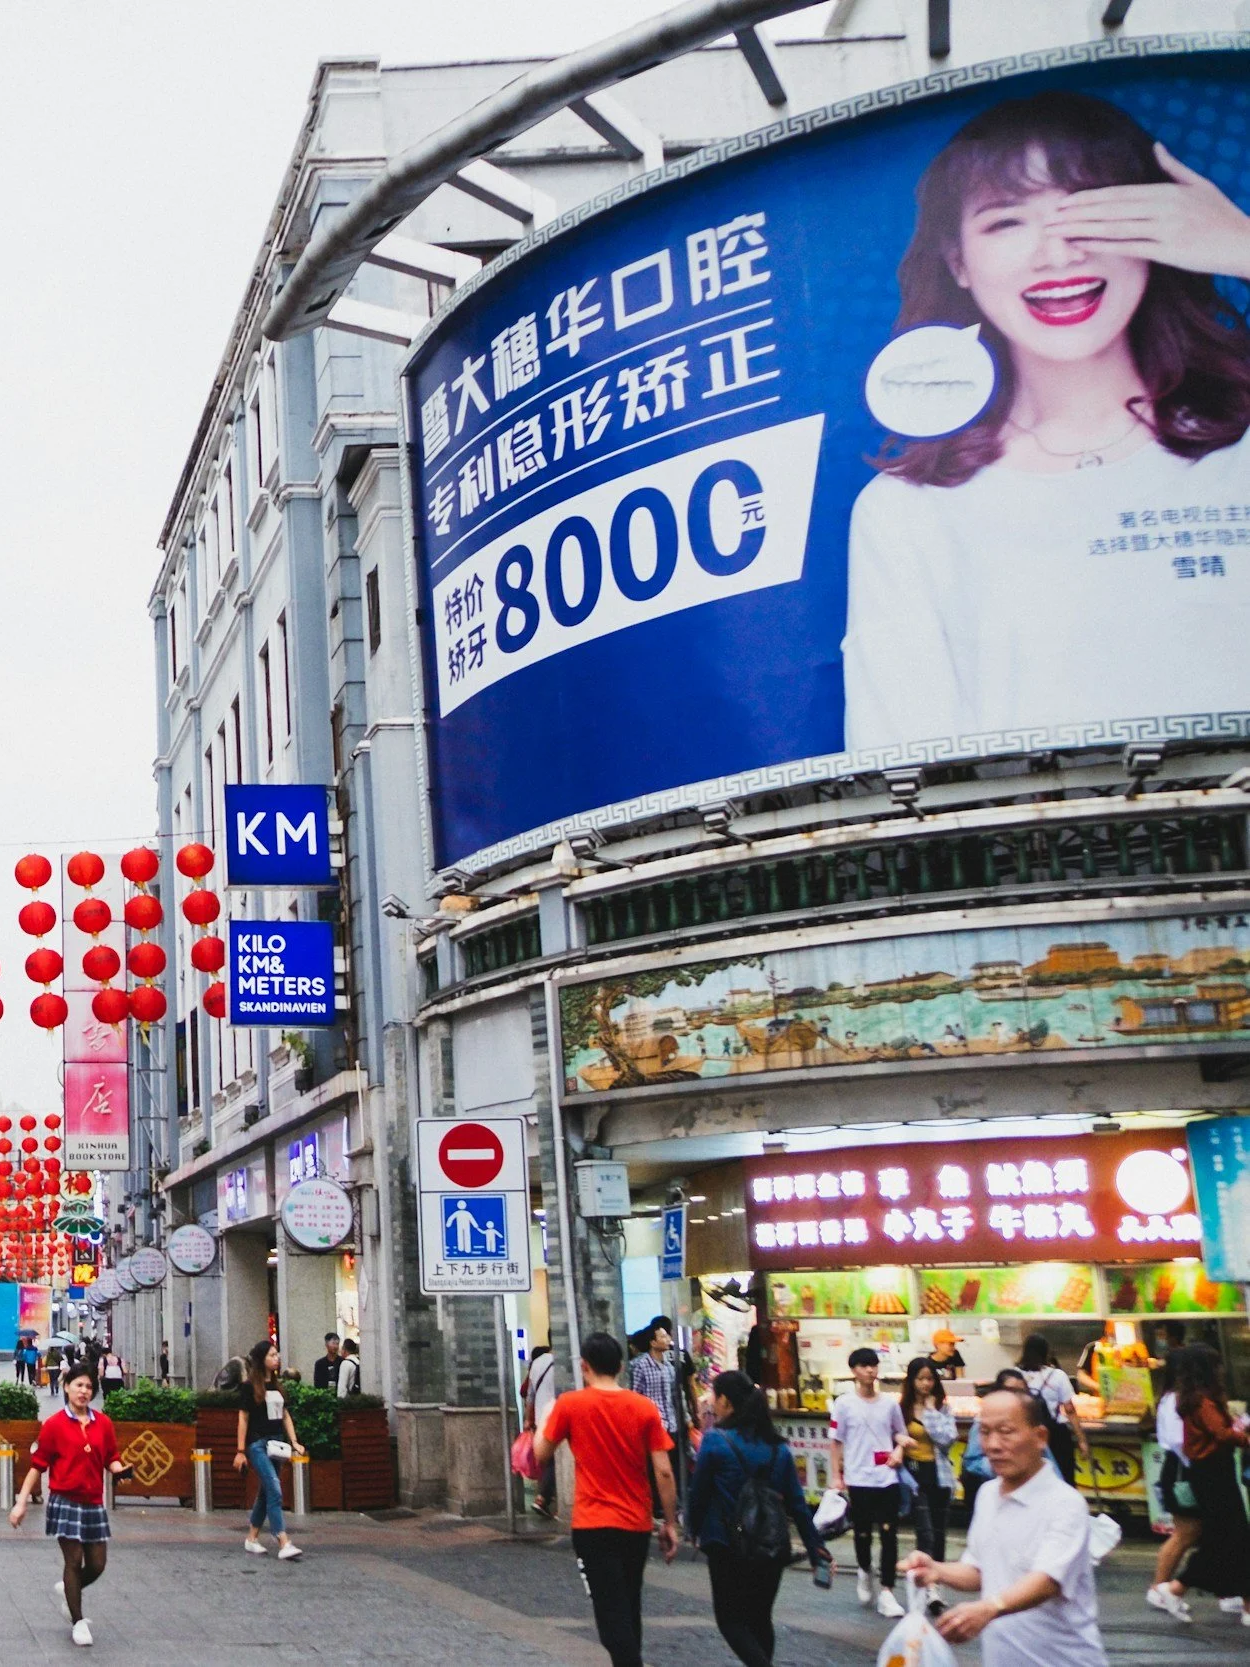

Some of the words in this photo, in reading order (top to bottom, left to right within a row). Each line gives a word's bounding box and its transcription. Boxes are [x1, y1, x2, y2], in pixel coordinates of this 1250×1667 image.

[420, 211, 771, 468] 暨大穗华口腔
[427, 317, 781, 537] 专利隐形矫正
[444, 571, 486, 636] 特价
[447, 621, 487, 686] 矫牙
[236, 811, 318, 856] KM
[237, 933, 287, 954] KILO
[237, 955, 286, 975] KM&
[238, 976, 327, 996] METERS
[239, 1001, 327, 1014] SKANDINAVIEN
[432, 1262, 519, 1276] 上下九步行街
